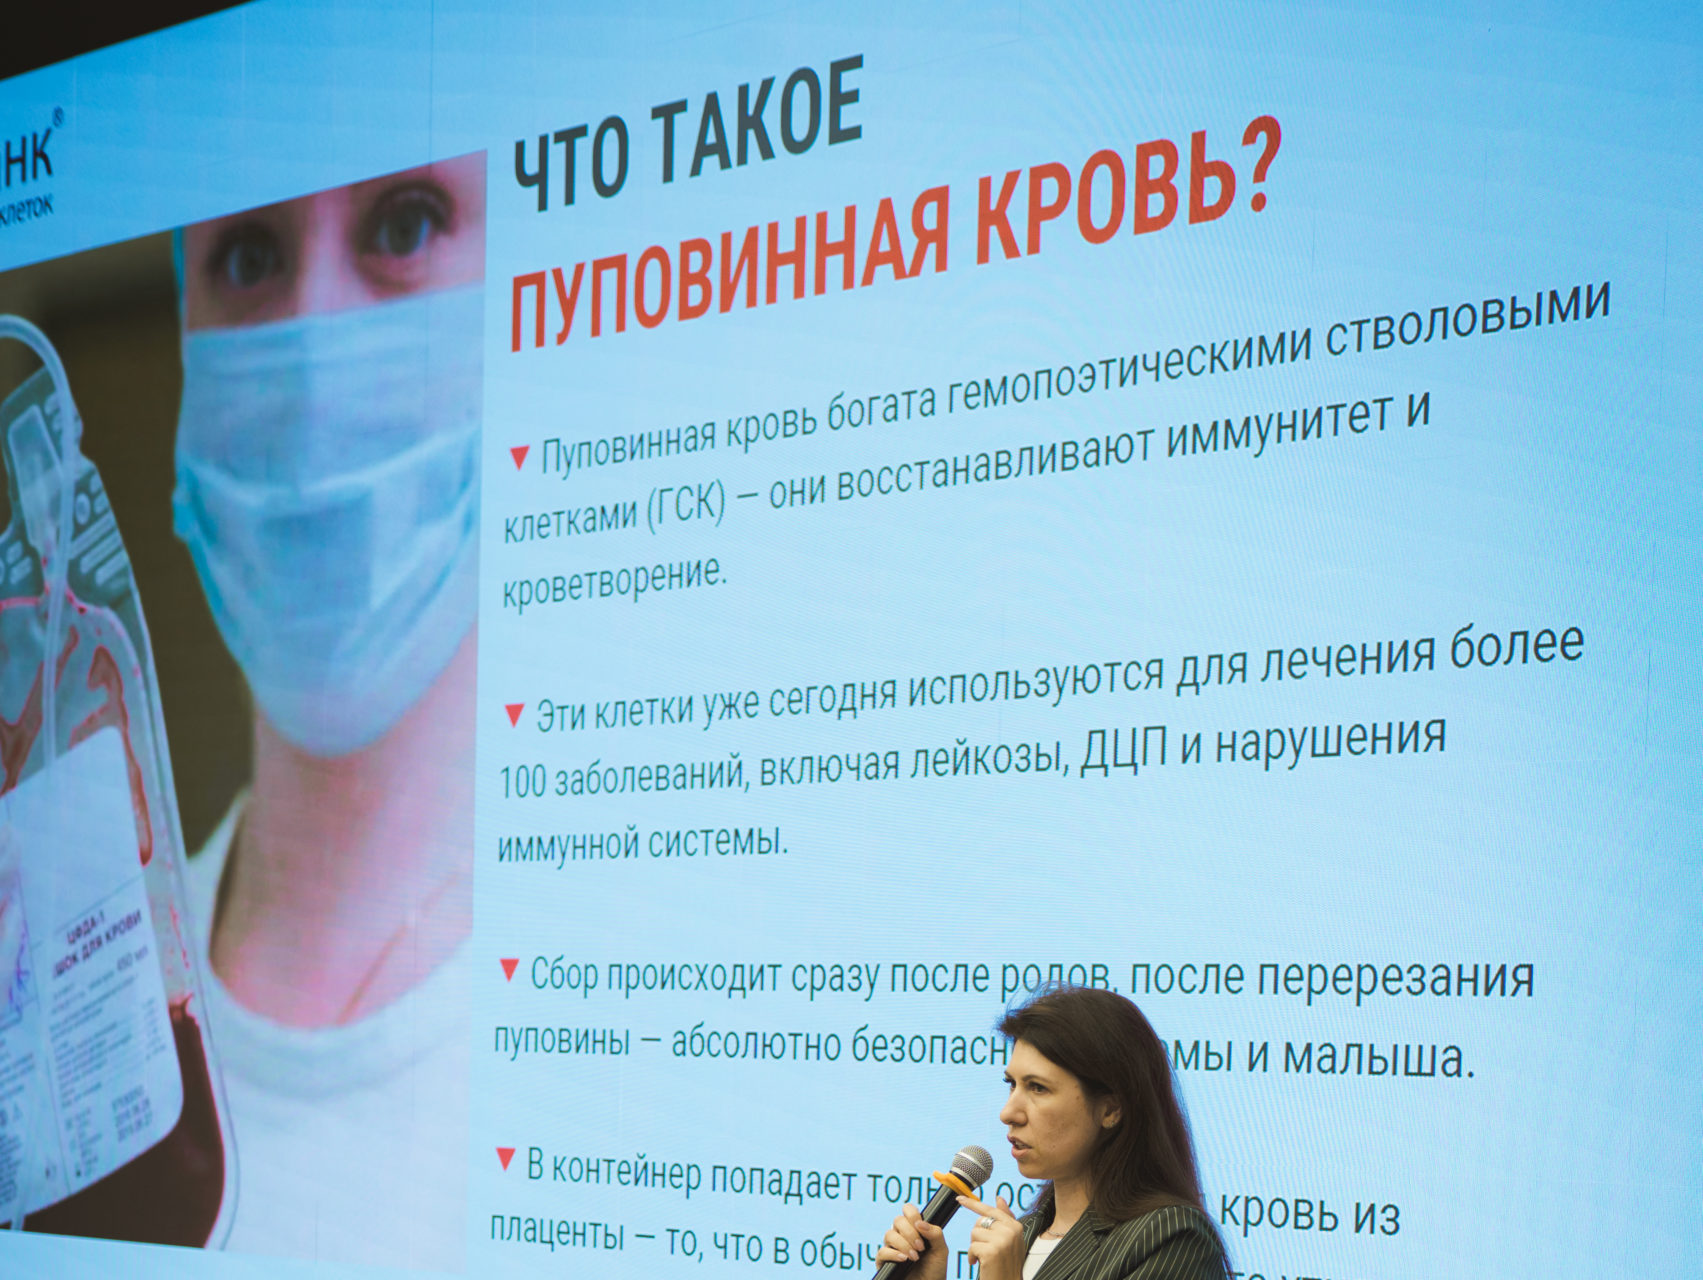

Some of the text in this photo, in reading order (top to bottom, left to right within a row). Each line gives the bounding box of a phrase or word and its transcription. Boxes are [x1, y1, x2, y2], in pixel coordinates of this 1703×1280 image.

[515, 53, 864, 213] ЧТО ТАКОЕ
[512, 116, 1281, 352] ПУПОВИННАЯ КРОВЬ?
[543, 281, 1610, 480] Пуповинная кровь богата гемопоэтическими стволовыми
[505, 501, 637, 543] клетками
[647, 479, 725, 535] (ГСК)
[770, 475, 825, 509] они
[838, 429, 1155, 501] восстанавливают
[1168, 397, 1394, 458] иммунитет
[1408, 392, 1430, 427] и
[504, 558, 726, 615] кроветворение.
[538, 622, 1584, 733] Эти клетки уже сегодня используются для лечения более
[501, 719, 1446, 798] 100 заболеваний, включая лейкозы, ДЦП и нарушения
[499, 824, 787, 870] иммунной системы.
[532, 955, 598, 999] Сбор
[608, 964, 782, 999] происходит
[792, 963, 880, 1002] сразу
[891, 963, 989, 992] после
[1132, 963, 1244, 994] после
[1259, 963, 1534, 1007] перерезания
[495, 1026, 629, 1061] пуповины
[672, 1021, 841, 1061] абсолютно
[852, 1024, 1007, 1066] безопасн
[1248, 1041, 1268, 1073] и
[1284, 1042, 1474, 1078] малыша.
[528, 1147, 543, 1180] В
[553, 1153, 701, 1200] контейнер
[712, 1165, 858, 1206] попадает
[1222, 1194, 1339, 1238] кровь
[1354, 1202, 1400, 1236] из
[491, 1215, 623, 1252] плаценты
[665, 1228, 703, 1263] то,
[714, 1232, 763, 1262] что
[774, 1237, 790, 1264] в
[801, 1231, 881, 1271] обыч
